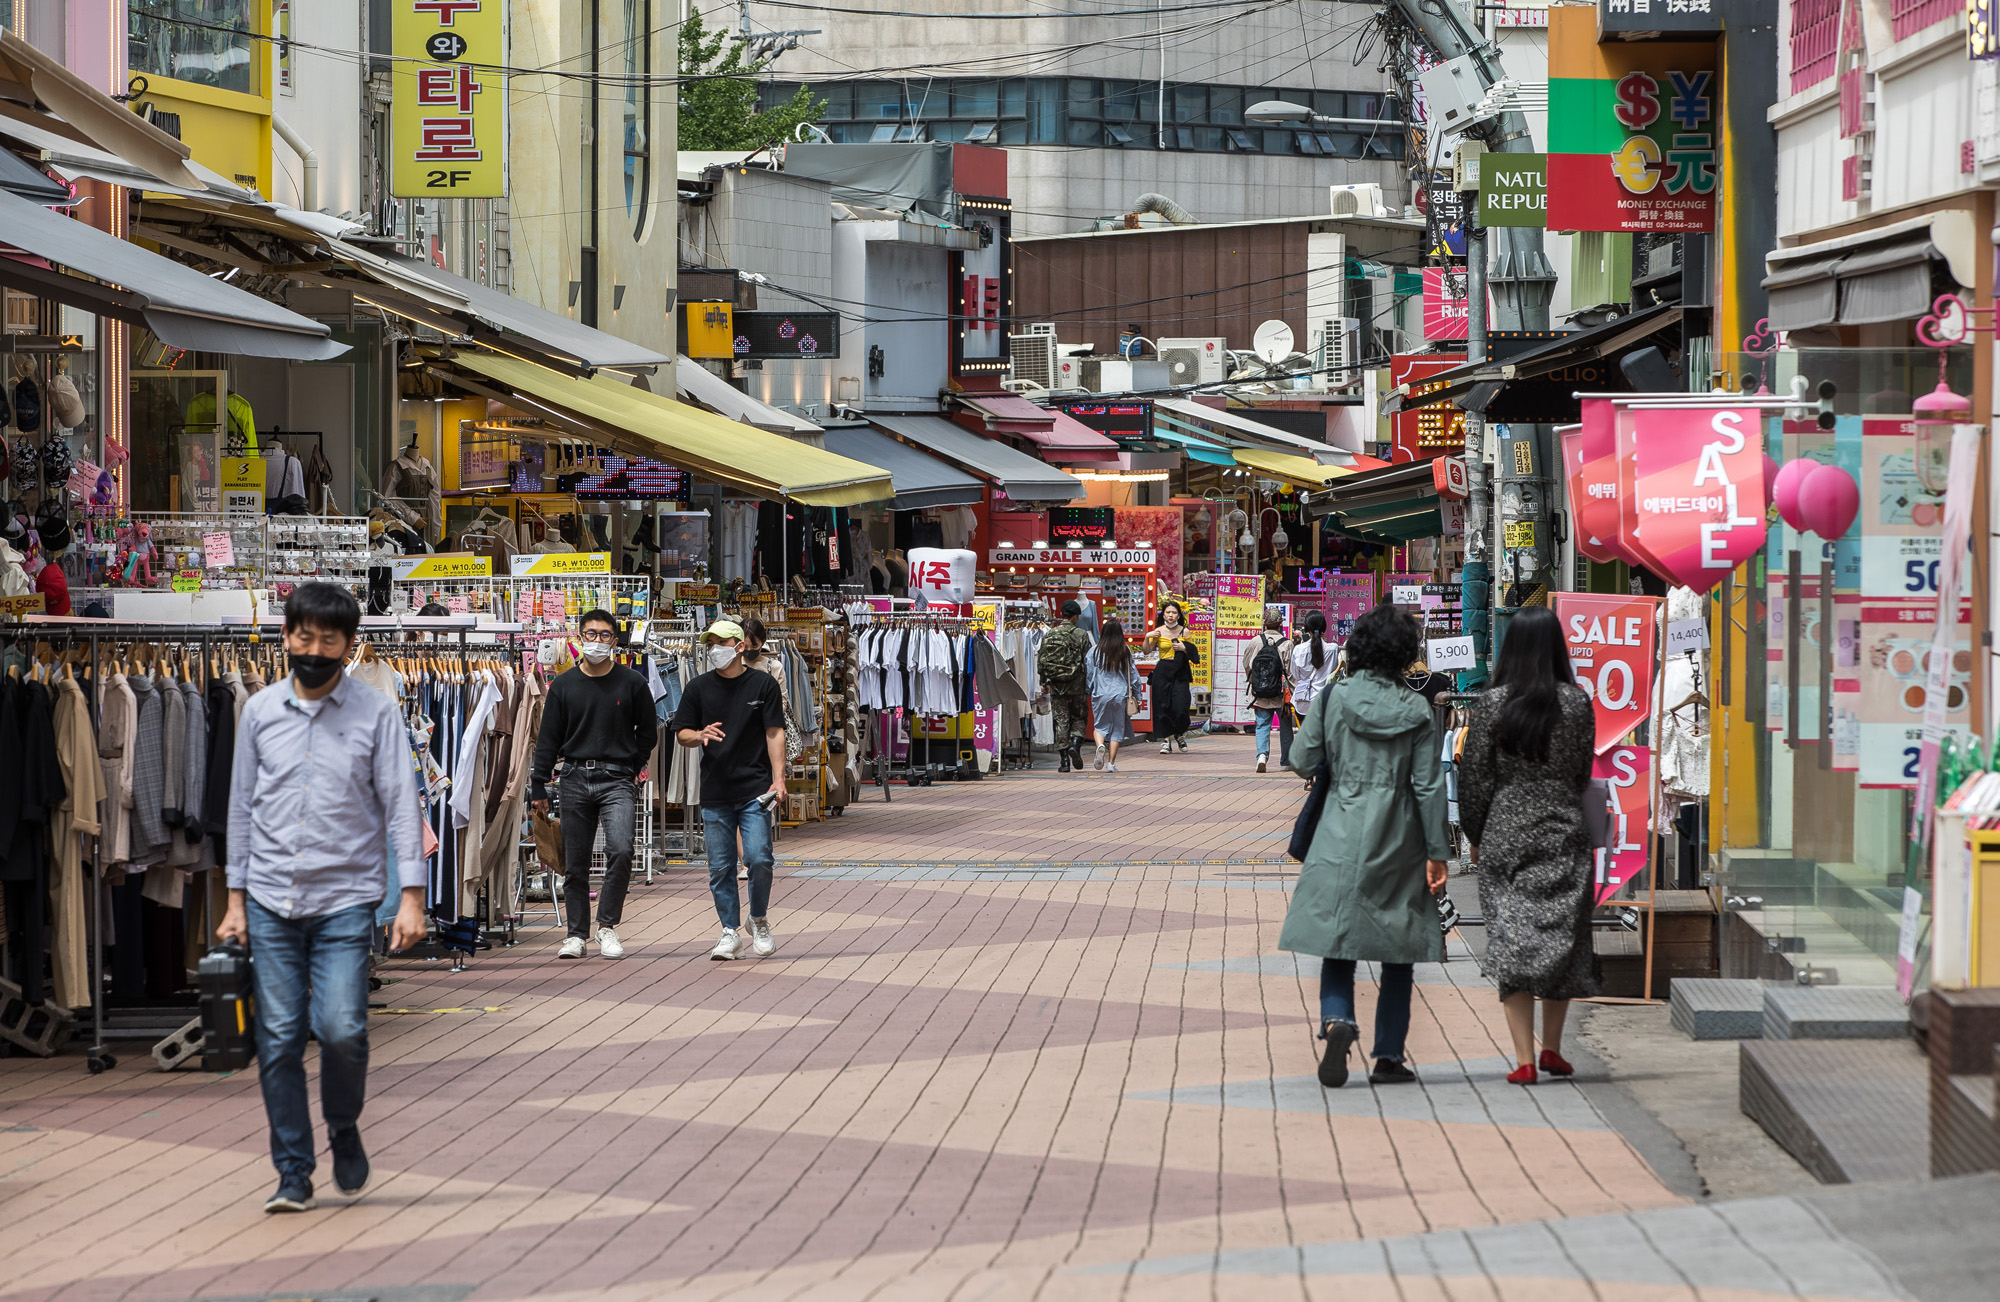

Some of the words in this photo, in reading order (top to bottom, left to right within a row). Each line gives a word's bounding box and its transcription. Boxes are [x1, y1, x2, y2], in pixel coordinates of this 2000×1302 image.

[1662, 133, 1717, 196] 元
[426, 171, 472, 188] 2F
[1495, 171, 1547, 188] NATU
[1617, 200, 1653, 209] MONEY
[1656, 200, 1707, 209] EXCHANGE
[1548, 367, 1598, 382] CLIO
[1643, 496, 1723, 514] 에뛰드데이
[995, 553, 1035, 562] GRAND
[1039, 550, 1082, 563] SALE
[1090, 551, 1150, 564] ₩10,000
[181, 570, 201, 578] SALE!
[433, 564, 448, 572] 2EA
[908, 560, 951, 591] 사주
[1220, 576, 1231, 585] 사주
[15, 598, 40, 610] size
[1568, 614, 1642, 646] SALE
[1435, 644, 1469, 659] 5,900
[1569, 646, 1594, 657] UPTO
